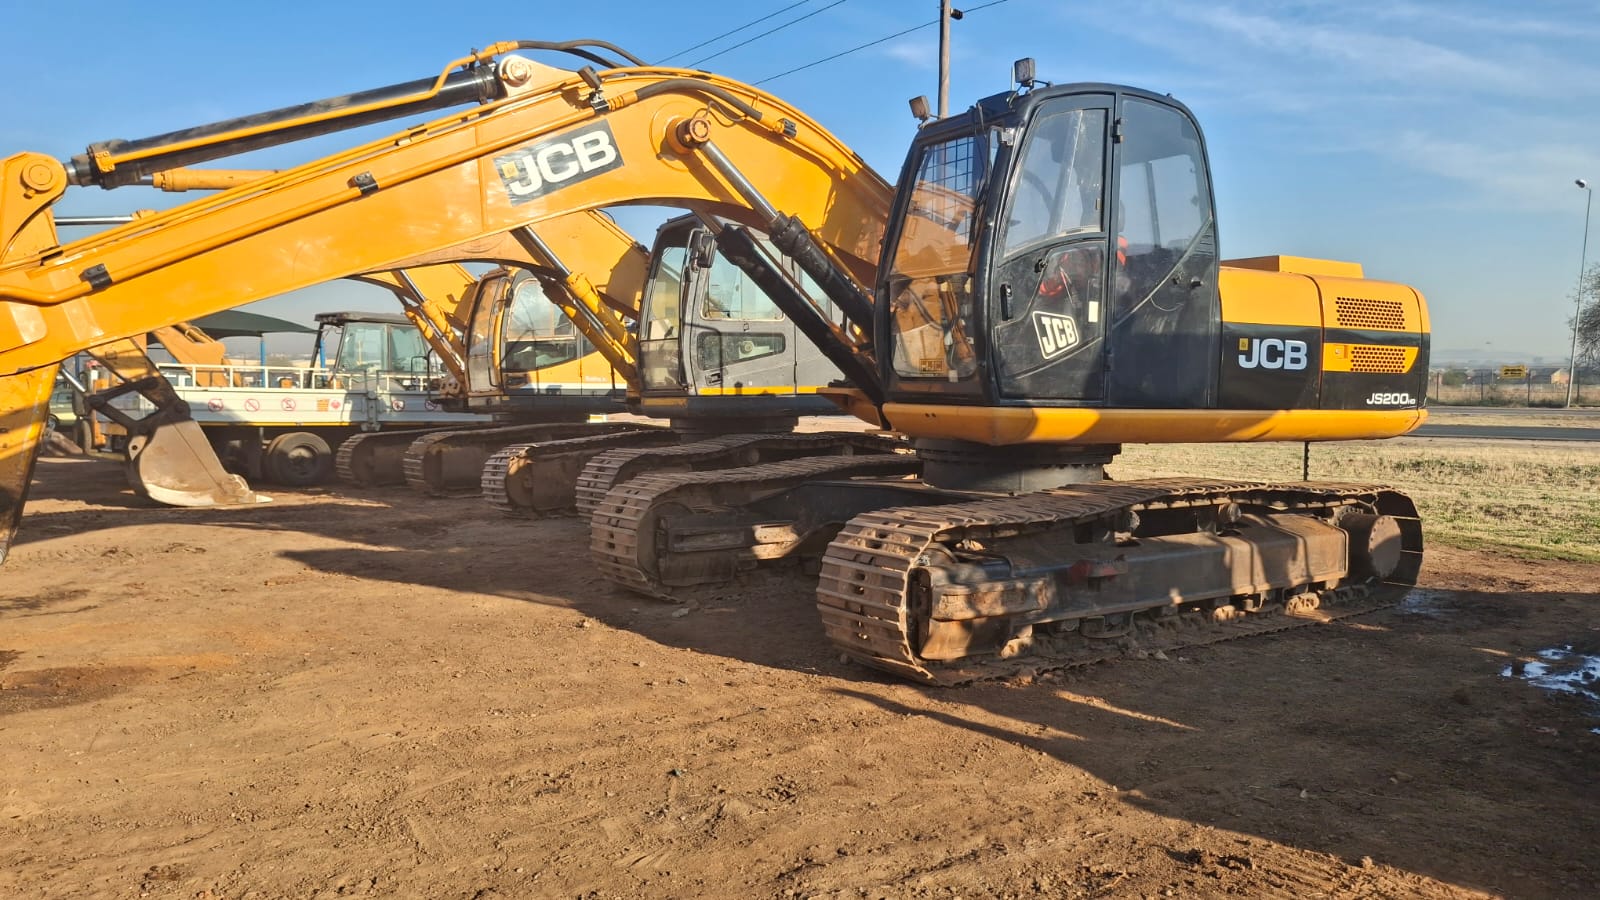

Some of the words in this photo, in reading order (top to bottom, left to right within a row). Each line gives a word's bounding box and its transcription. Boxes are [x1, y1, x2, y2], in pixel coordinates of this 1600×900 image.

[509, 130, 617, 195] JCB
[1041, 316, 1076, 354] JCB
[1238, 338, 1307, 370] JCB
